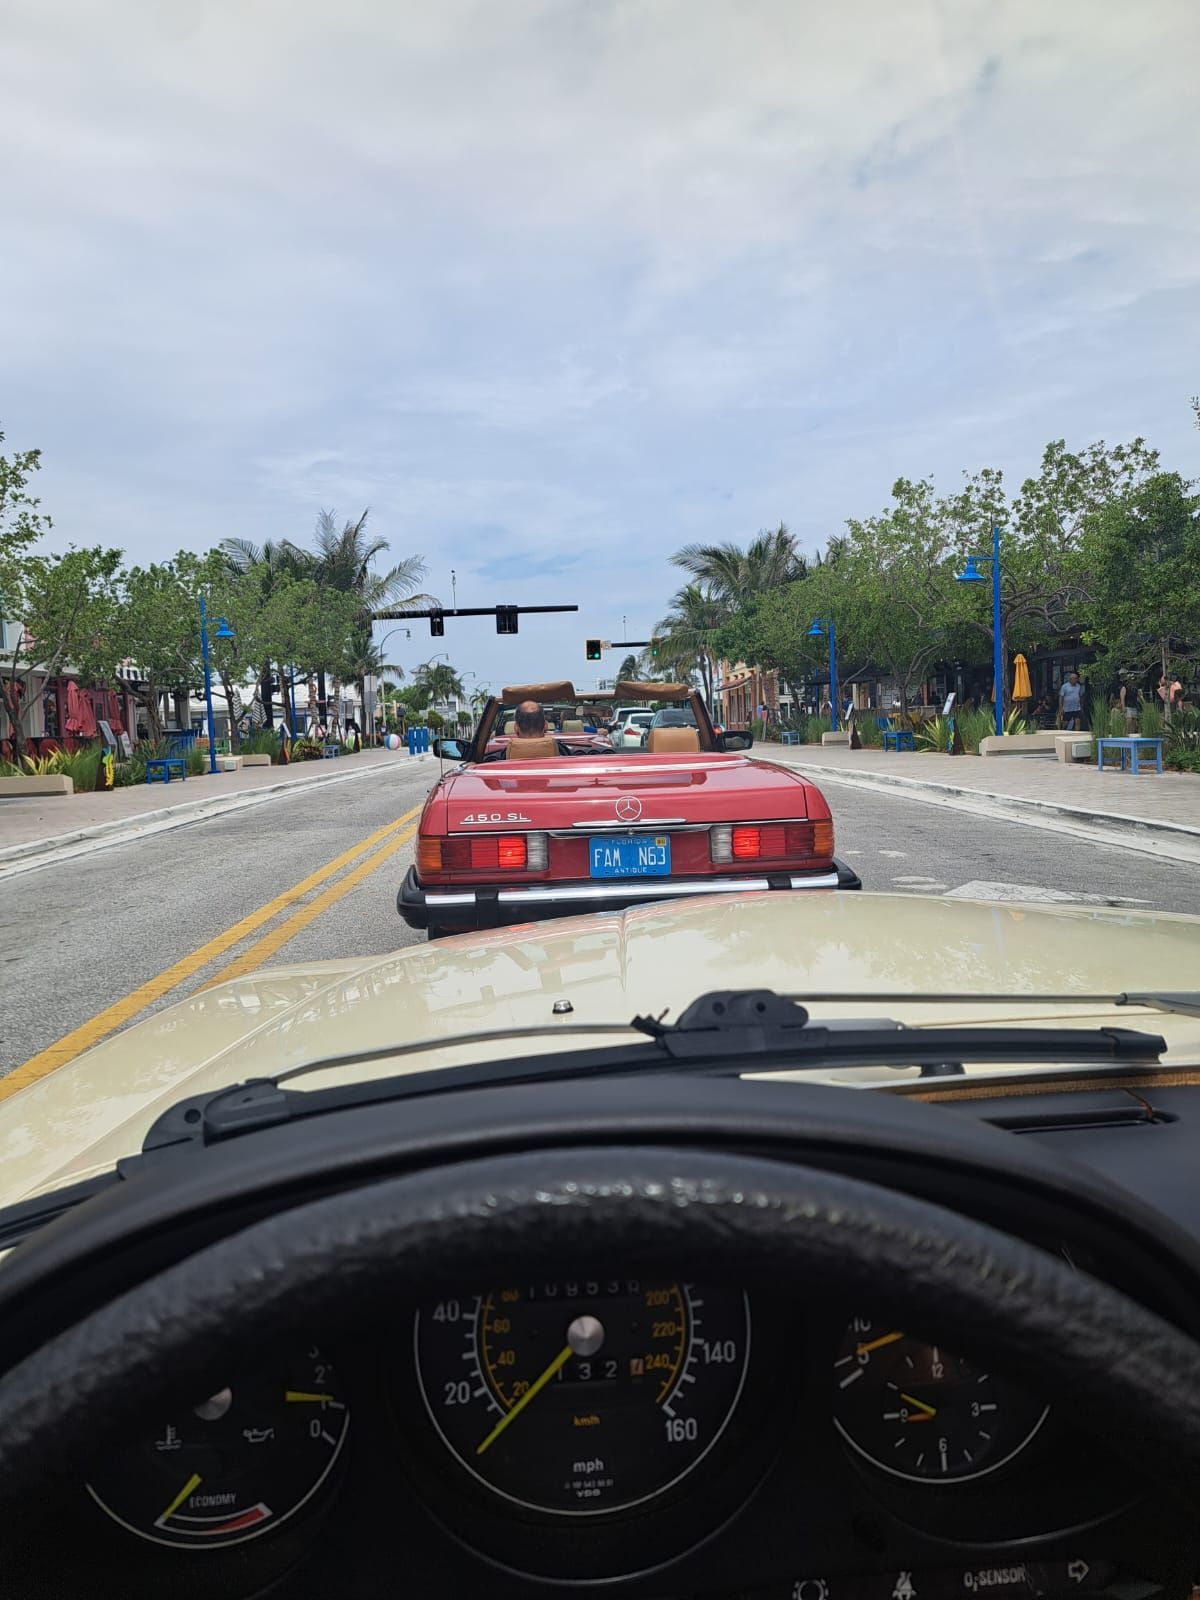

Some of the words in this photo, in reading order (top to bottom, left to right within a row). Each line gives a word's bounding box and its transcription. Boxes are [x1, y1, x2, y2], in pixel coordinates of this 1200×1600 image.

[464, 813, 501, 822] 450
[507, 812, 528, 821] SL
[594, 847, 622, 868] FAM
[638, 846, 666, 866] N63
[614, 866, 648, 874] ANTIQUE
[645, 1290, 670, 1307] 200
[432, 1300, 460, 1322] 40
[651, 1321, 676, 1338] 220
[497, 1350, 516, 1366] 40
[702, 1340, 736, 1364] 140
[645, 1353, 670, 1370] 240
[314, 1364, 326, 1384] 2
[931, 1363, 945, 1379] 12
[444, 1381, 470, 1405] 20
[512, 1380, 530, 1397] 20
[970, 1402, 980, 1418] 3
[309, 1418, 320, 1438] 0
[665, 1417, 698, 1442] 160
[938, 1437, 948, 1452] 6
[573, 1457, 605, 1474] mph
[188, 1492, 237, 1509] ECONOMY
[978, 1566, 1027, 1587] SENSOR
